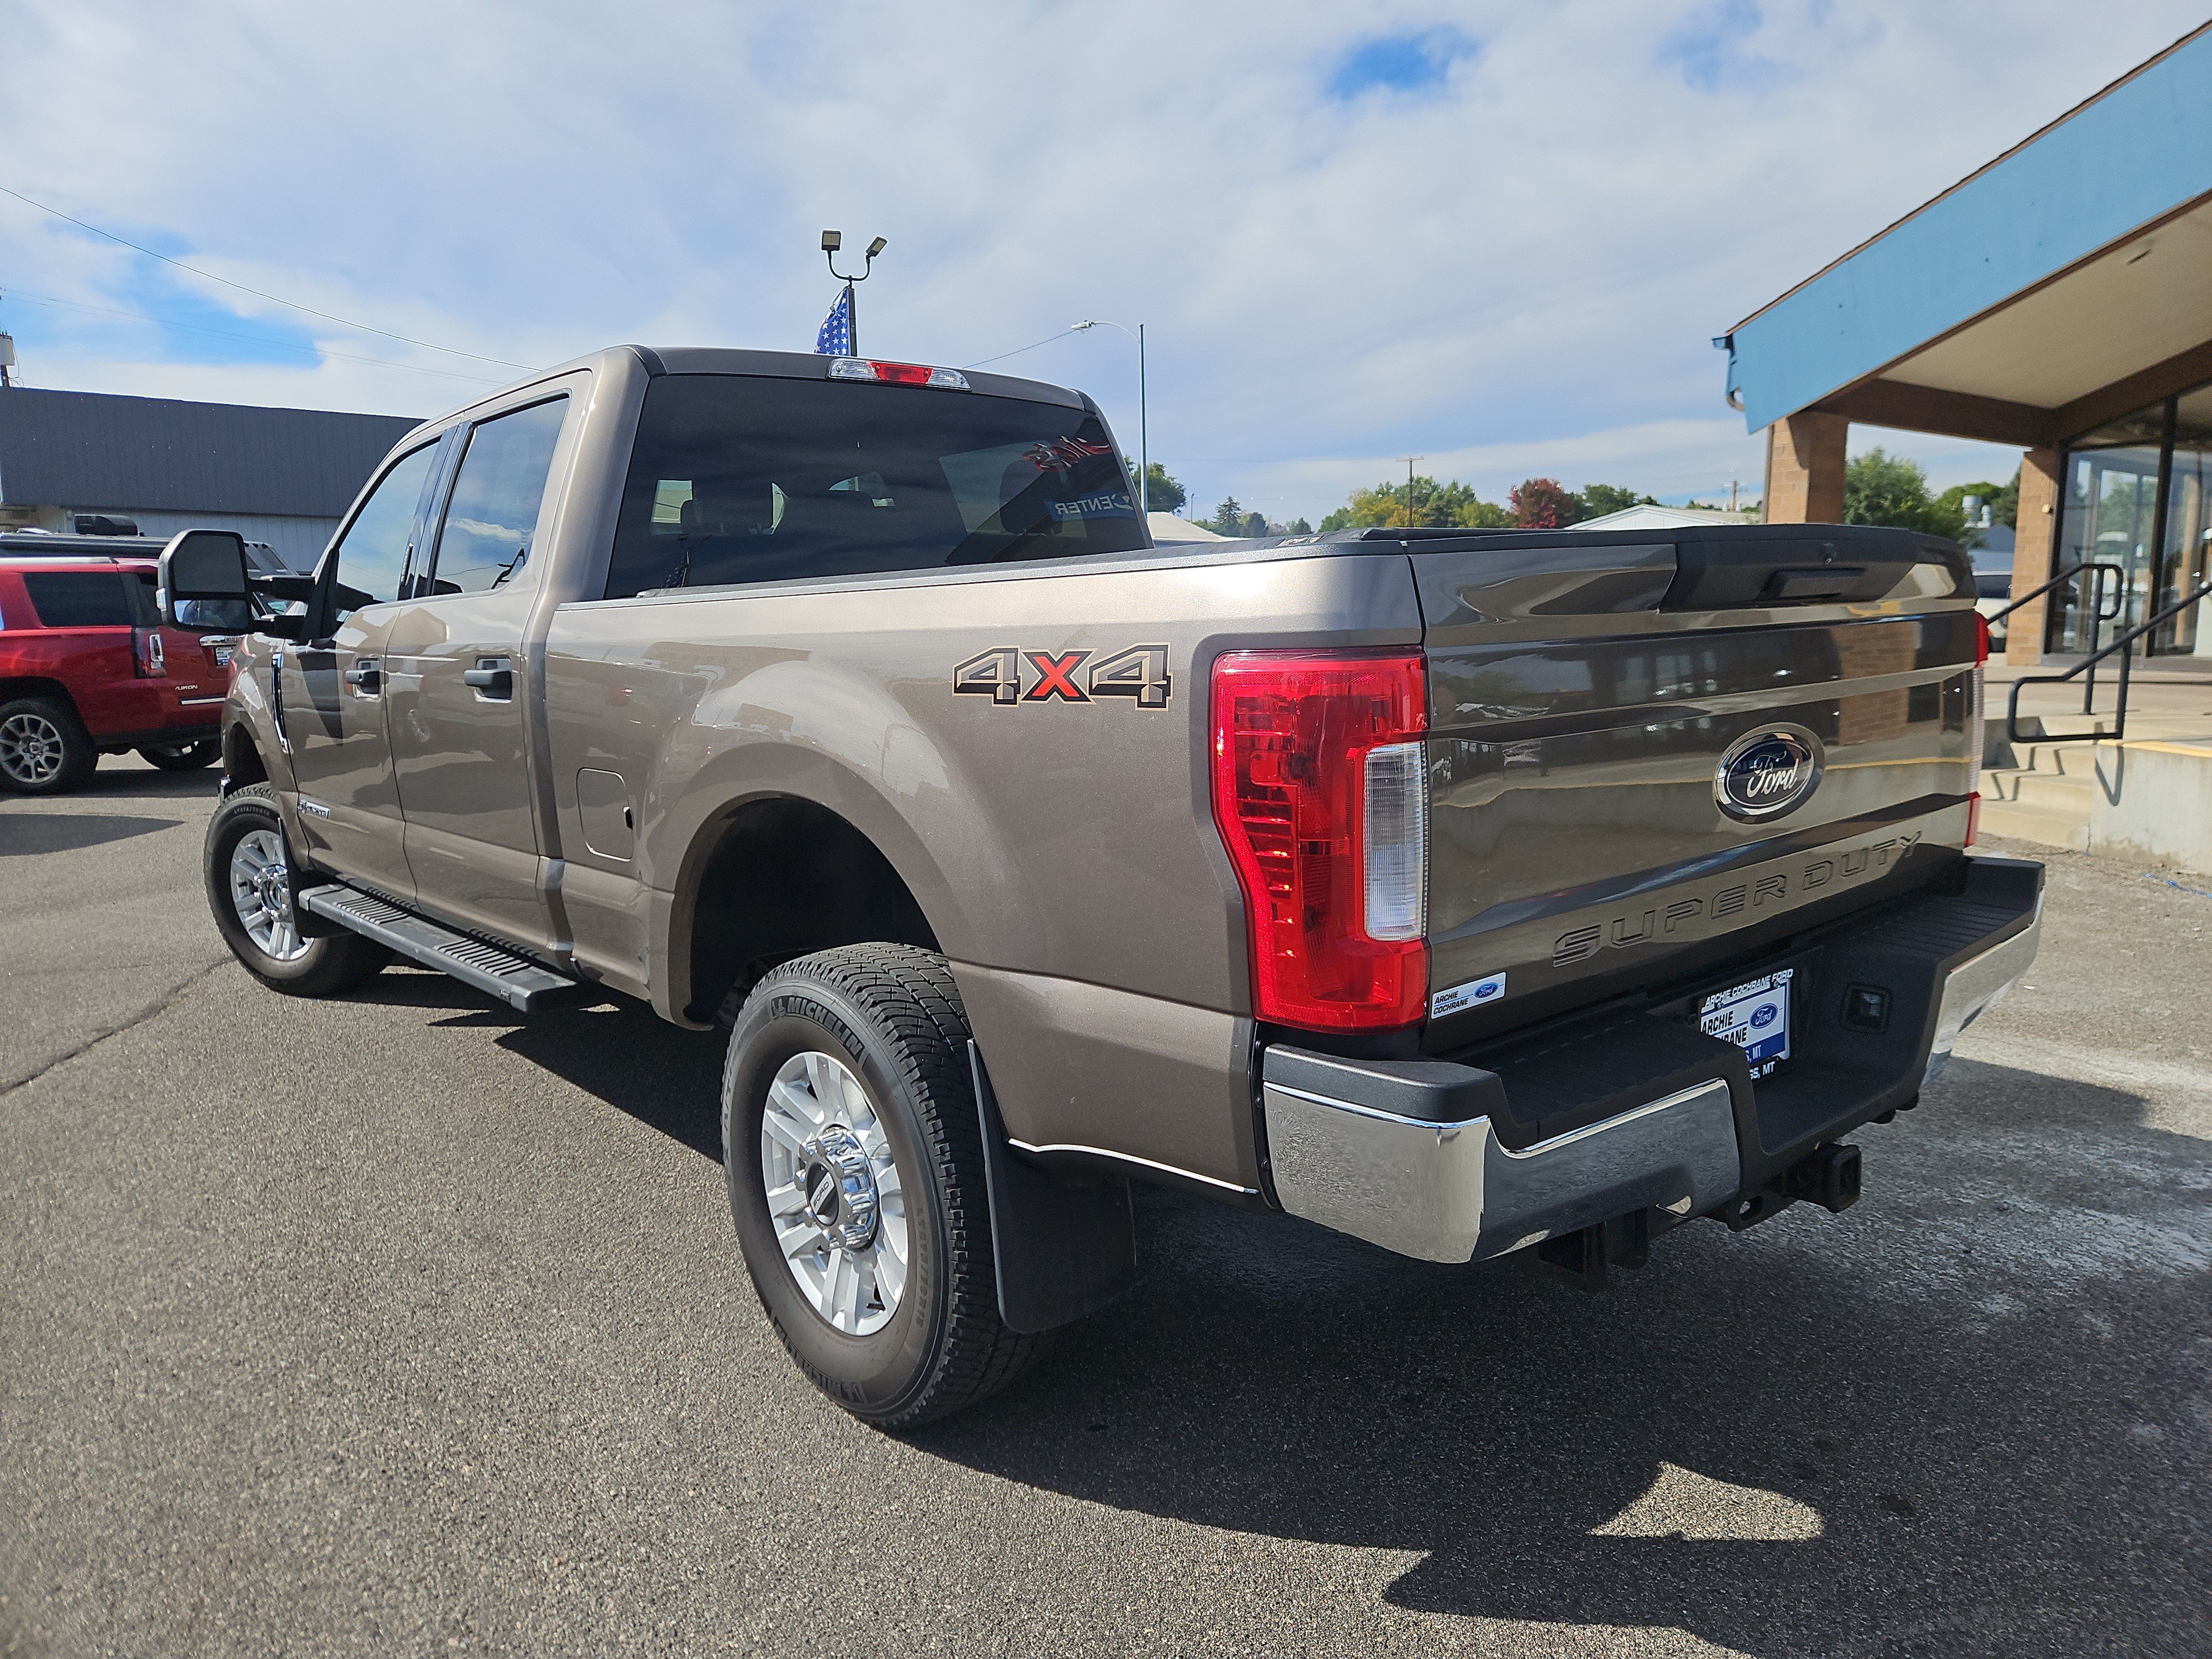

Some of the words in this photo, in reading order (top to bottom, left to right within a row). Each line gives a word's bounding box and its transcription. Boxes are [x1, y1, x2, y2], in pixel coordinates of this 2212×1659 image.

[1746, 751, 1800, 798] Ford
[1553, 873, 1788, 968] SUPER
[1802, 830, 1922, 891] DUTY
[1434, 990, 1459, 1004] ARCHIE
[1478, 985, 1494, 996] Ford
[1706, 988, 1731, 1007] ARCHIE
[1732, 975, 1771, 996] COCHRANE
[1771, 968, 1794, 983] FORD
[1433, 998, 1469, 1015] COCHRANE
[1755, 1007, 1773, 1025] Ford
[787, 997, 864, 1056] MICHELIN
[1702, 1010, 1734, 1034] ARCHIE
[1752, 1045, 1762, 1059] MT
[1763, 1061, 1776, 1076] MT
[813, 1181, 829, 1208] FORD
